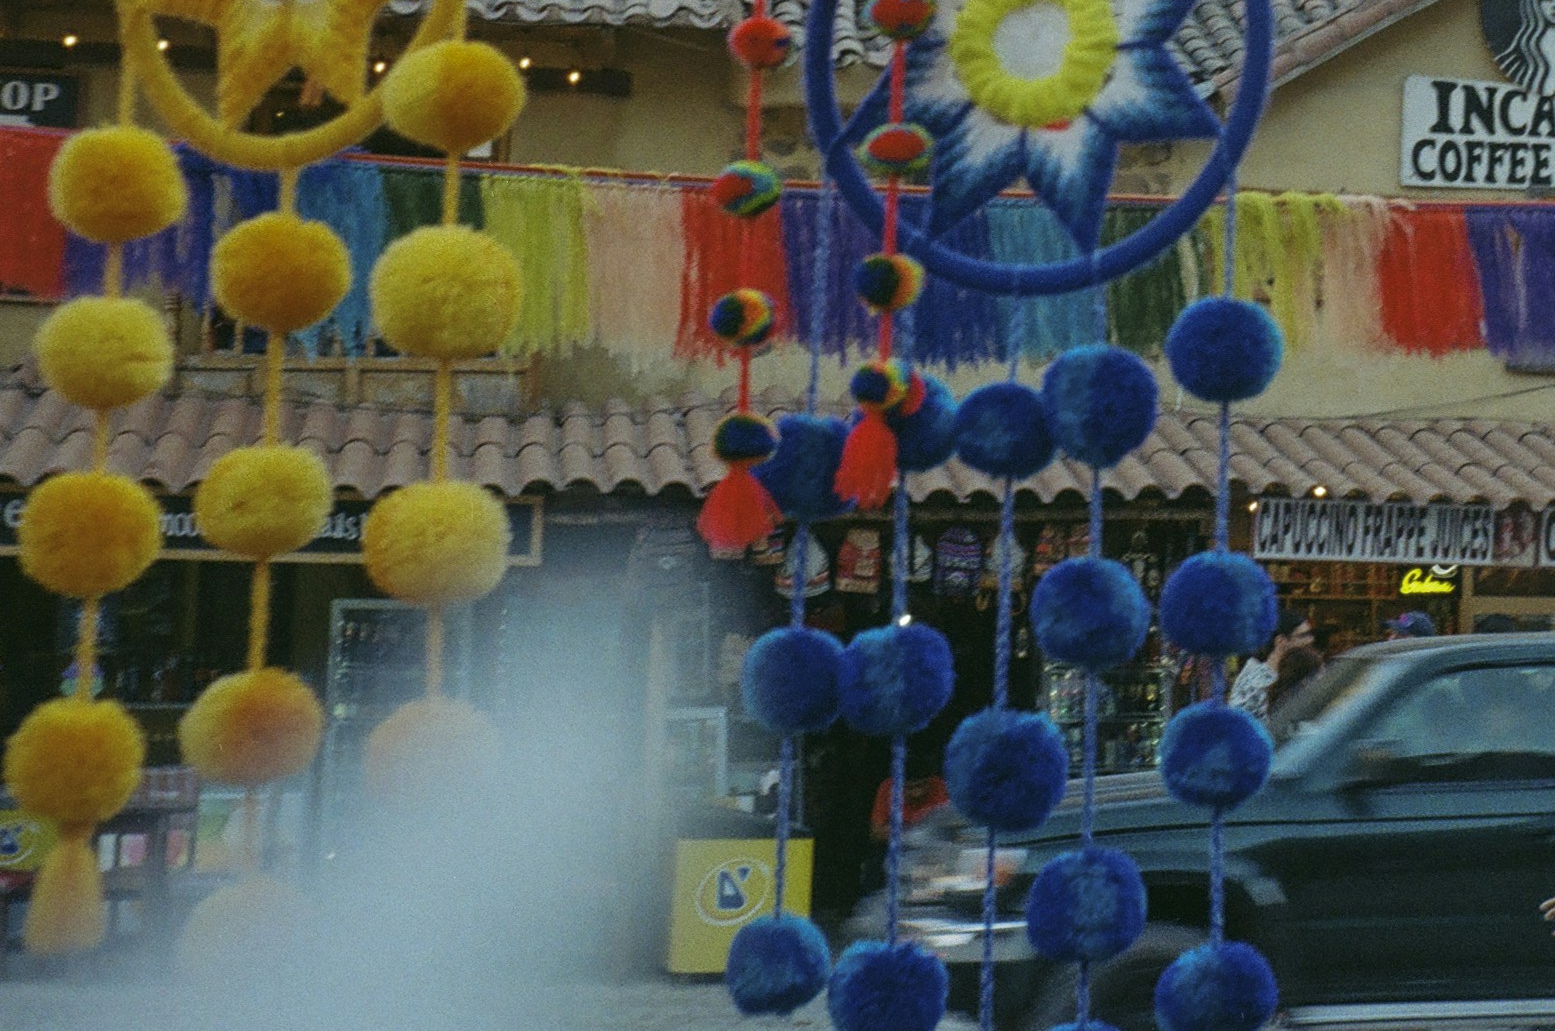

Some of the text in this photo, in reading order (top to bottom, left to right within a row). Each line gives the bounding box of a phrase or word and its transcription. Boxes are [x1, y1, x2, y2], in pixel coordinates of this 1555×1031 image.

[0, 80, 60, 111] OP
[1411, 139, 1552, 186] COFFEE
[1259, 500, 1491, 561] CAPUCCINO FRAPPE JUICES
